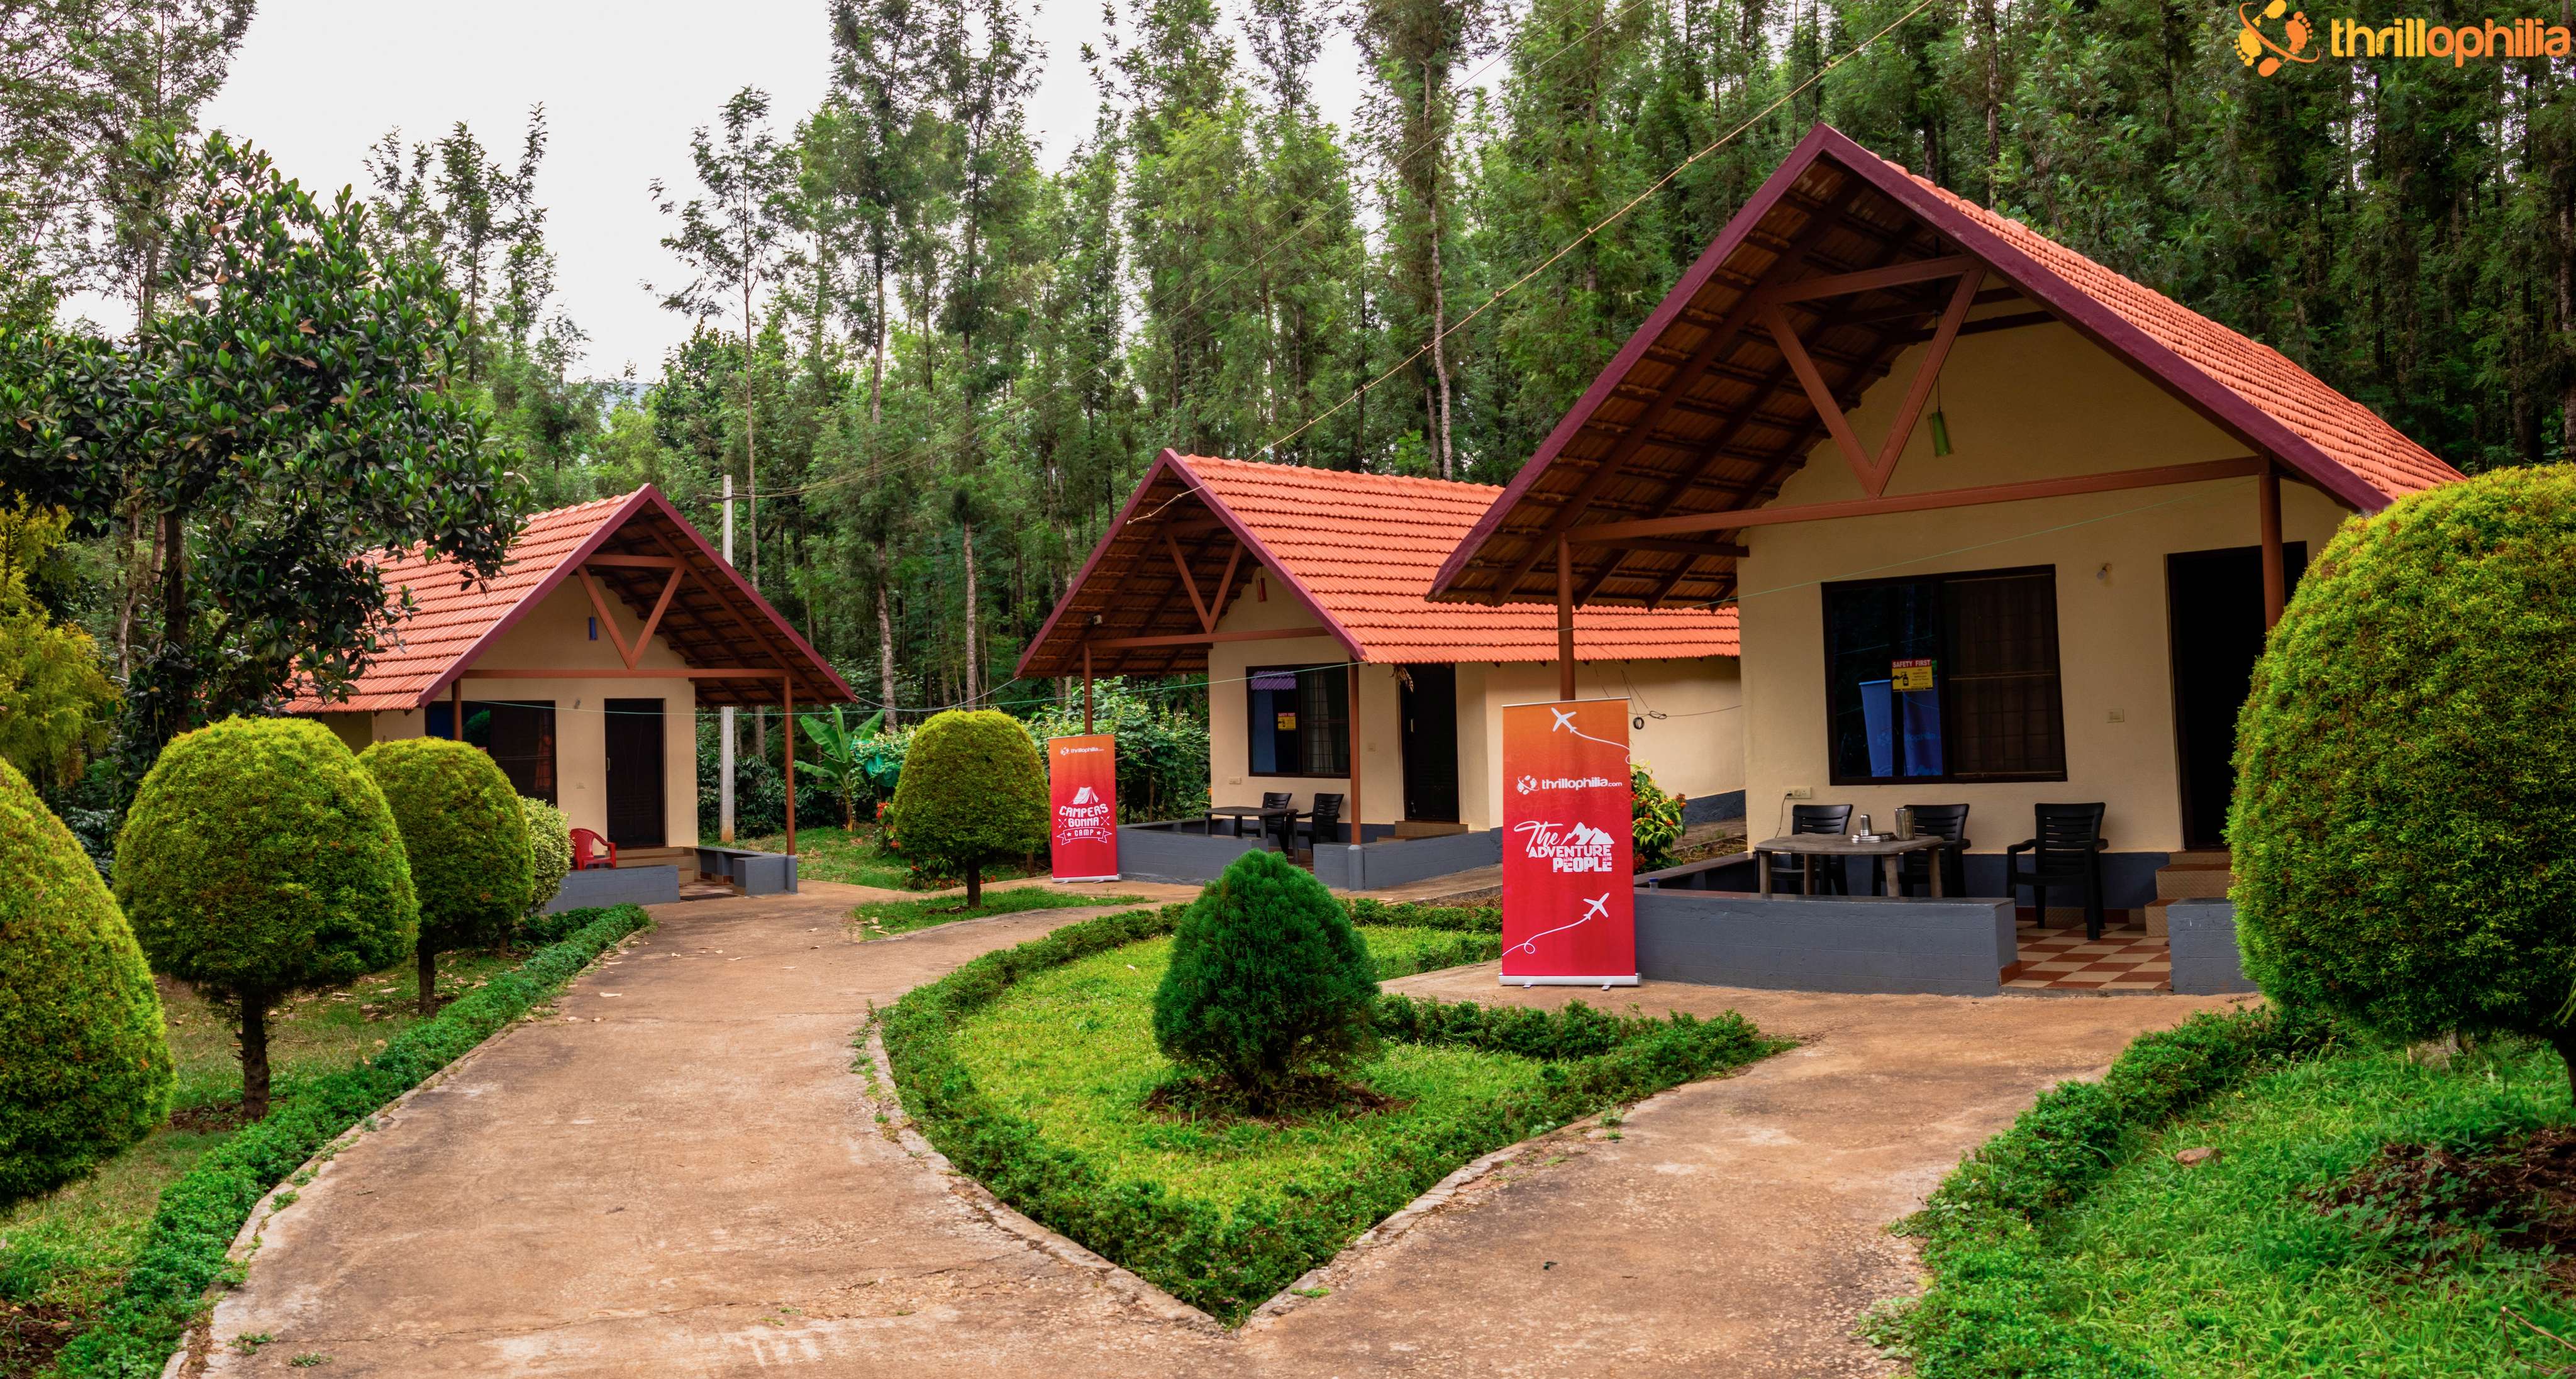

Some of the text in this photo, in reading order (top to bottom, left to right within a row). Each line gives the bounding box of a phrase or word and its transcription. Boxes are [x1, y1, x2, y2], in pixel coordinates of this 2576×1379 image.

[1541, 777, 1623, 791] thrillophilia.com
[1058, 803, 1109, 817] CAMPERS
[1067, 816, 1099, 828] GONNA
[1074, 829, 1094, 837] CAMP
[1513, 820, 1563, 853] The
[1528, 845, 1612, 858] ADVENTURE
[1552, 856, 1613, 873] PEOPLE
